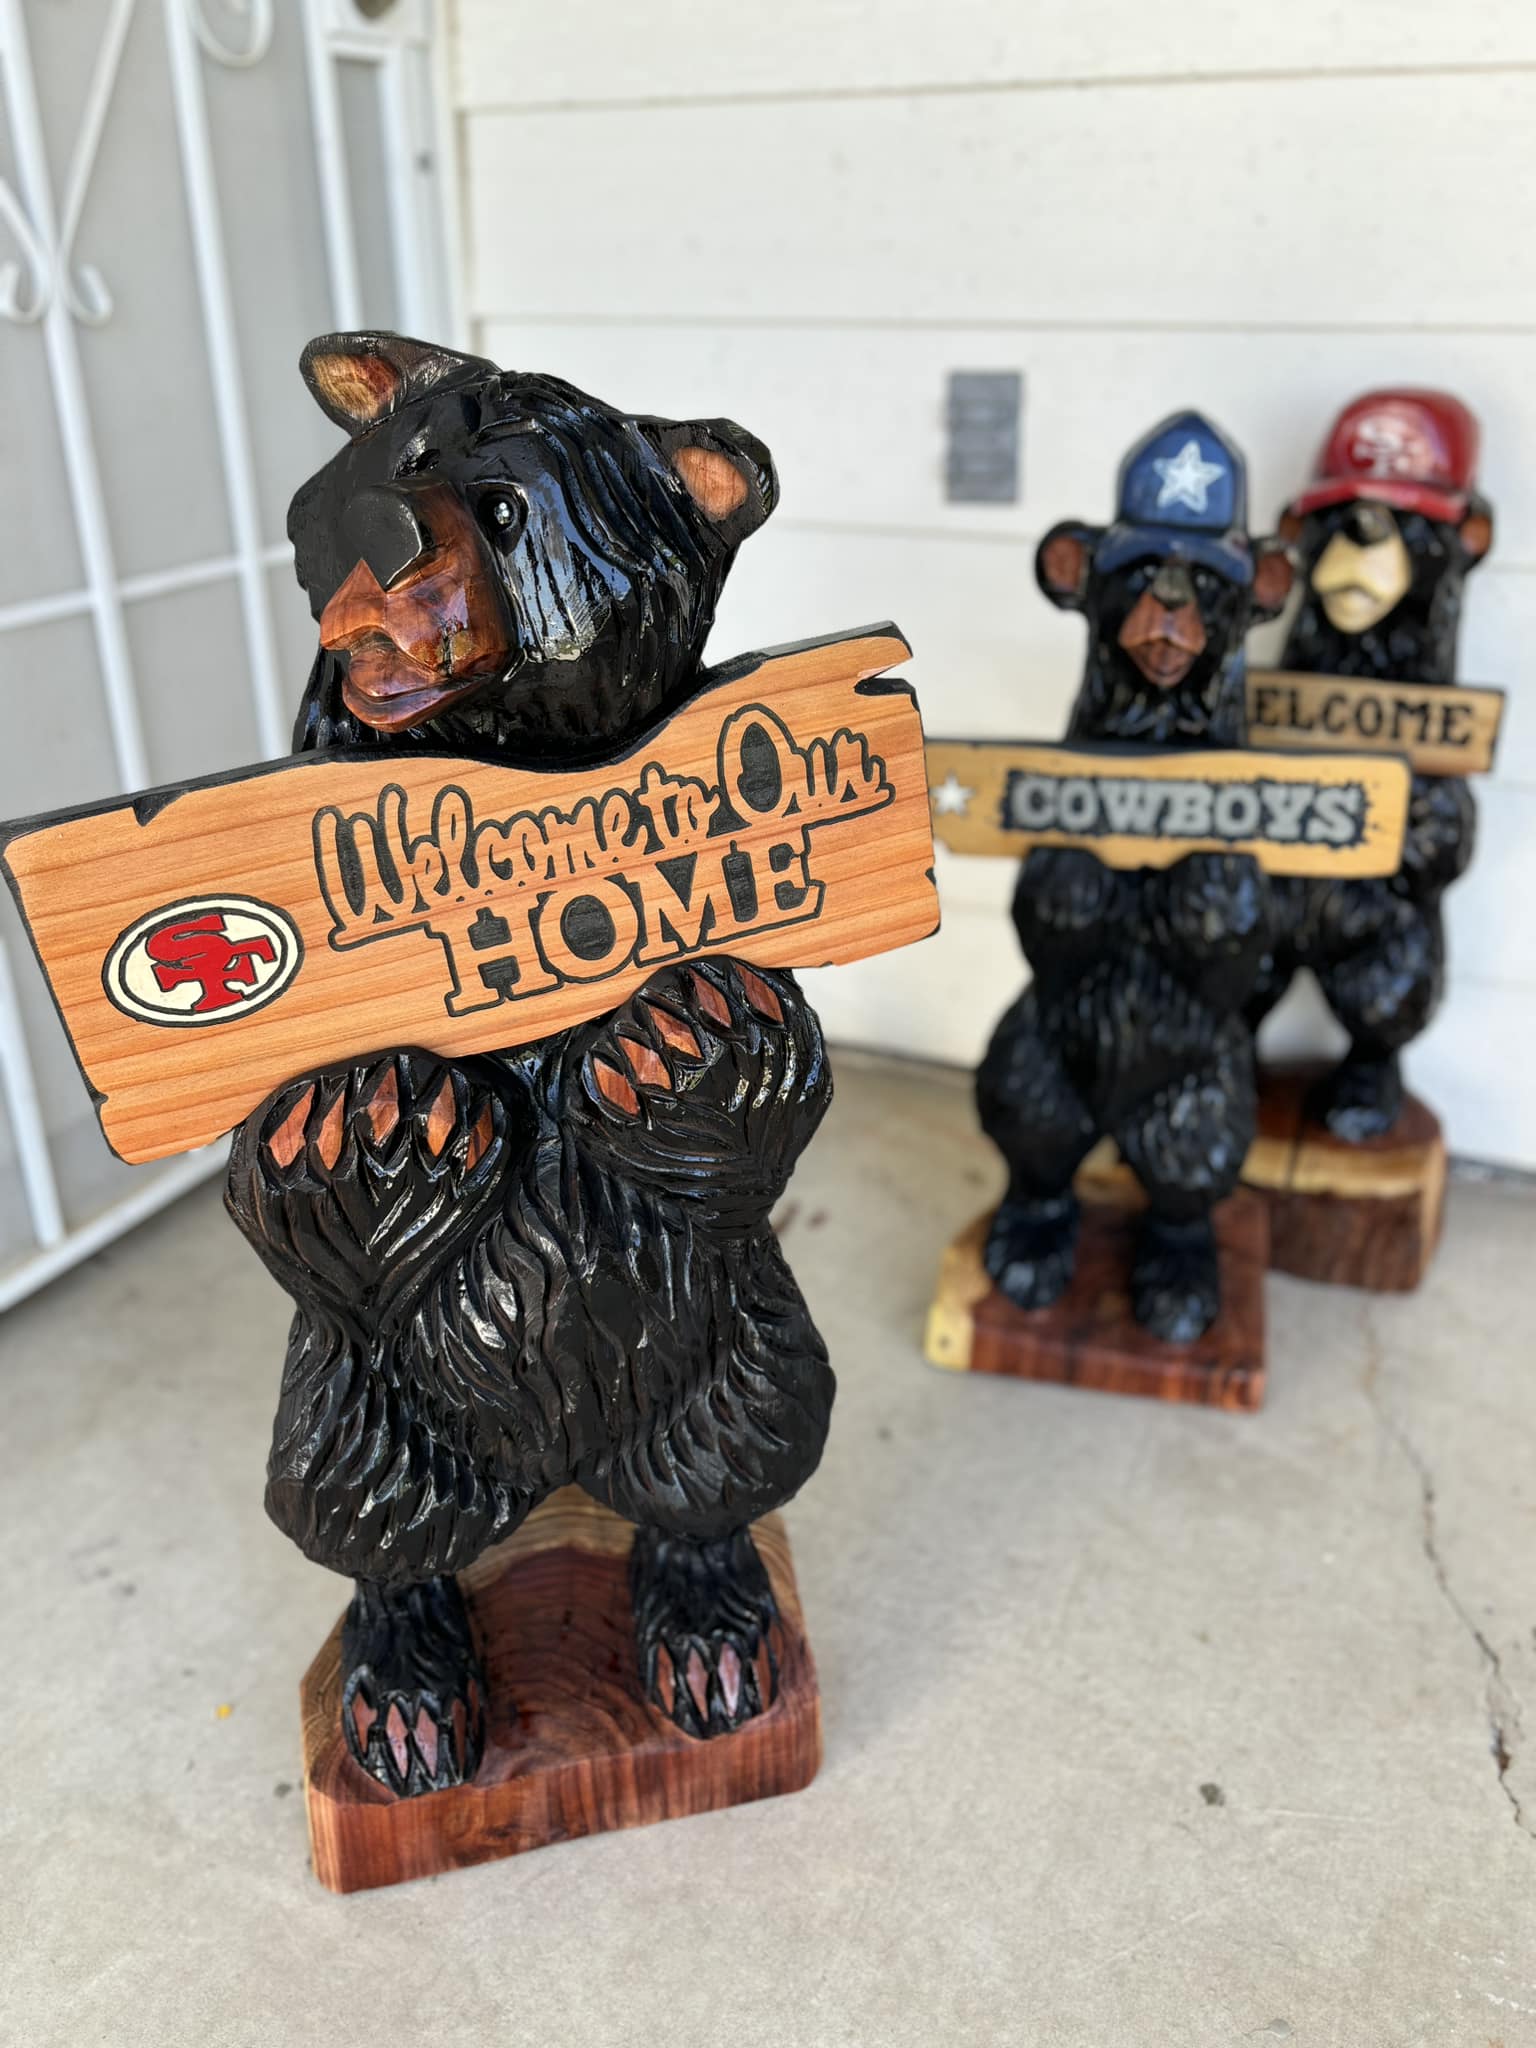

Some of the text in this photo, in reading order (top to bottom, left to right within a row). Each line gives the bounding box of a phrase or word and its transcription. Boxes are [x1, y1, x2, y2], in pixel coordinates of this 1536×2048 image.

[1254, 686, 1473, 746] ELCOME
[314, 704, 896, 951] Welcome to Our
[1010, 775, 1362, 845] COWBOYS
[144, 912, 277, 1013] SF
[444, 828, 826, 1017] HOME
